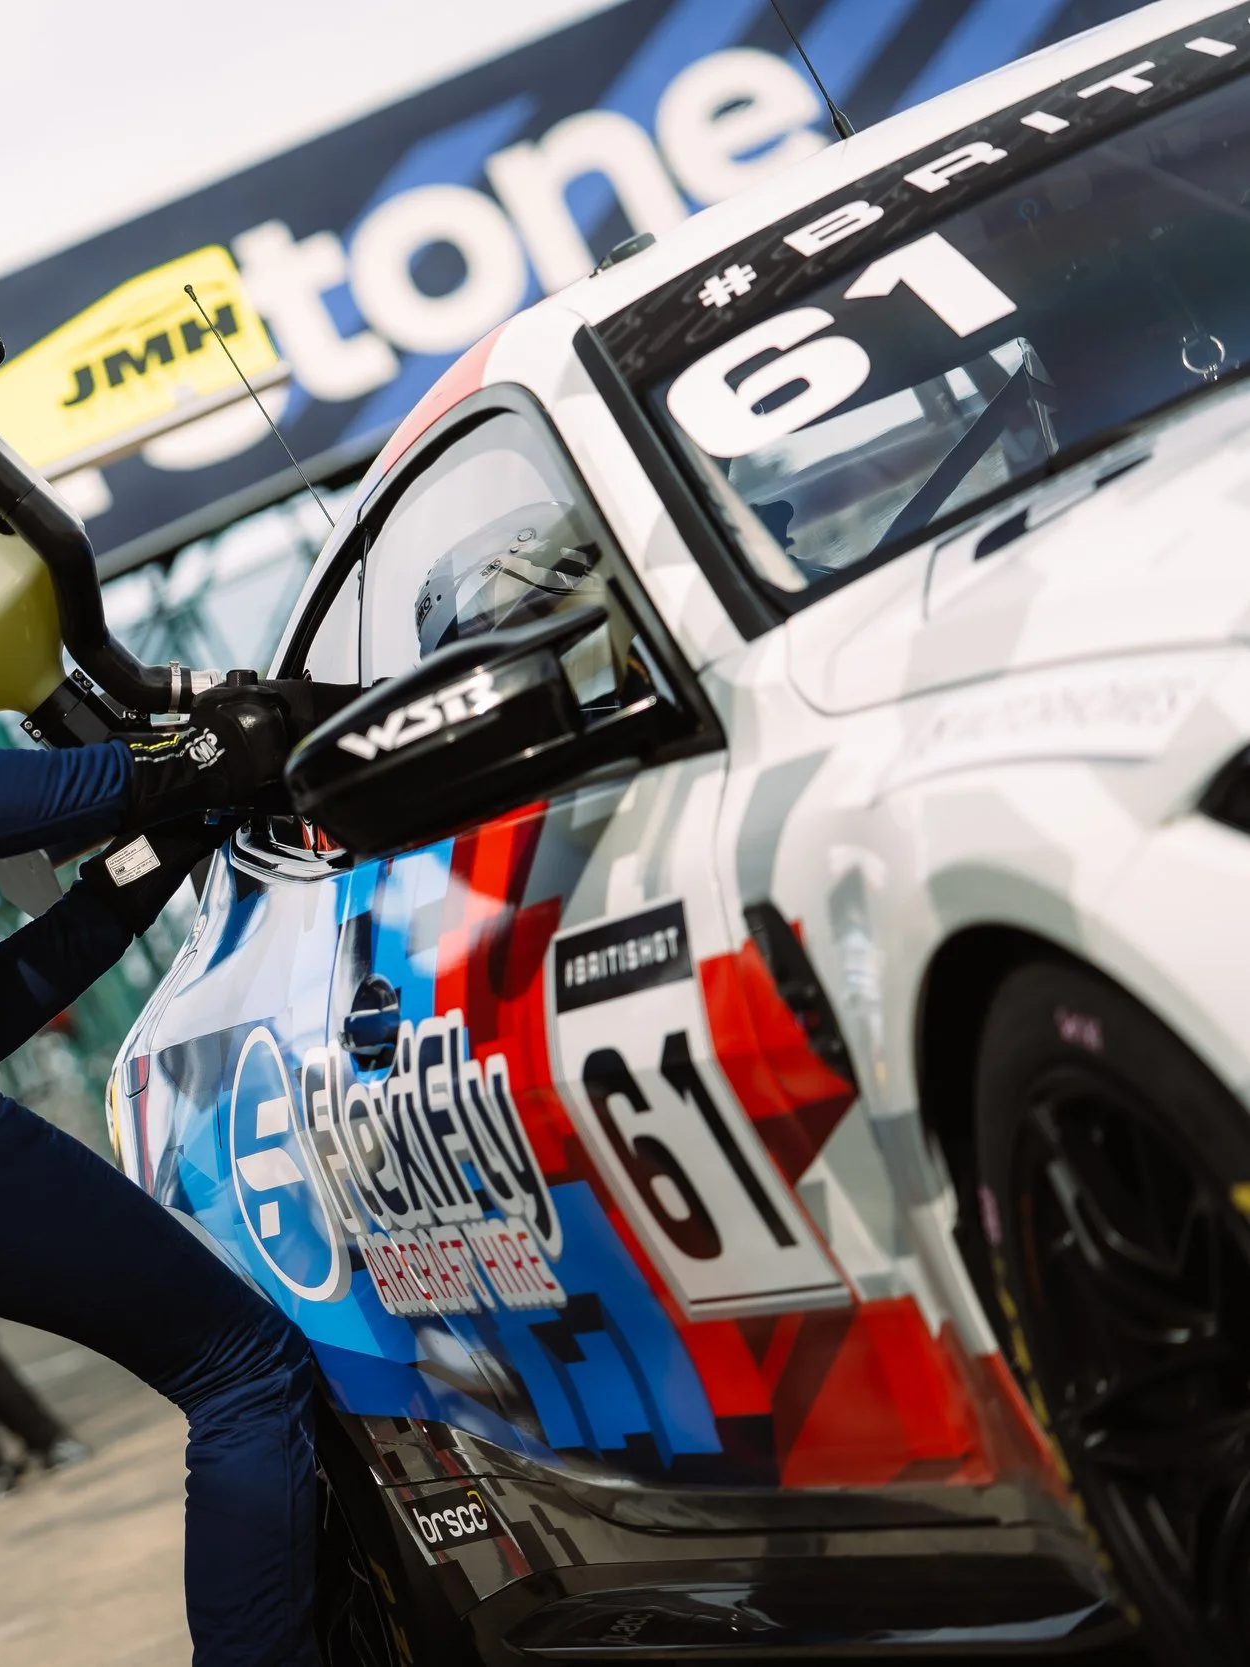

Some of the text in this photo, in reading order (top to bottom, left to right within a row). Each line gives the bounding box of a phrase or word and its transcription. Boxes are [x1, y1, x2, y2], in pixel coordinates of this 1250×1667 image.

[698, 17, 1250, 309] #BRITI
[63, 303, 239, 407] JMH
[666, 231, 1018, 459] 61
[581, 1030, 800, 1262] 61
[364, 1230, 558, 1304] AIRCRAFT HIRE
[412, 1502, 488, 1544] brscc
